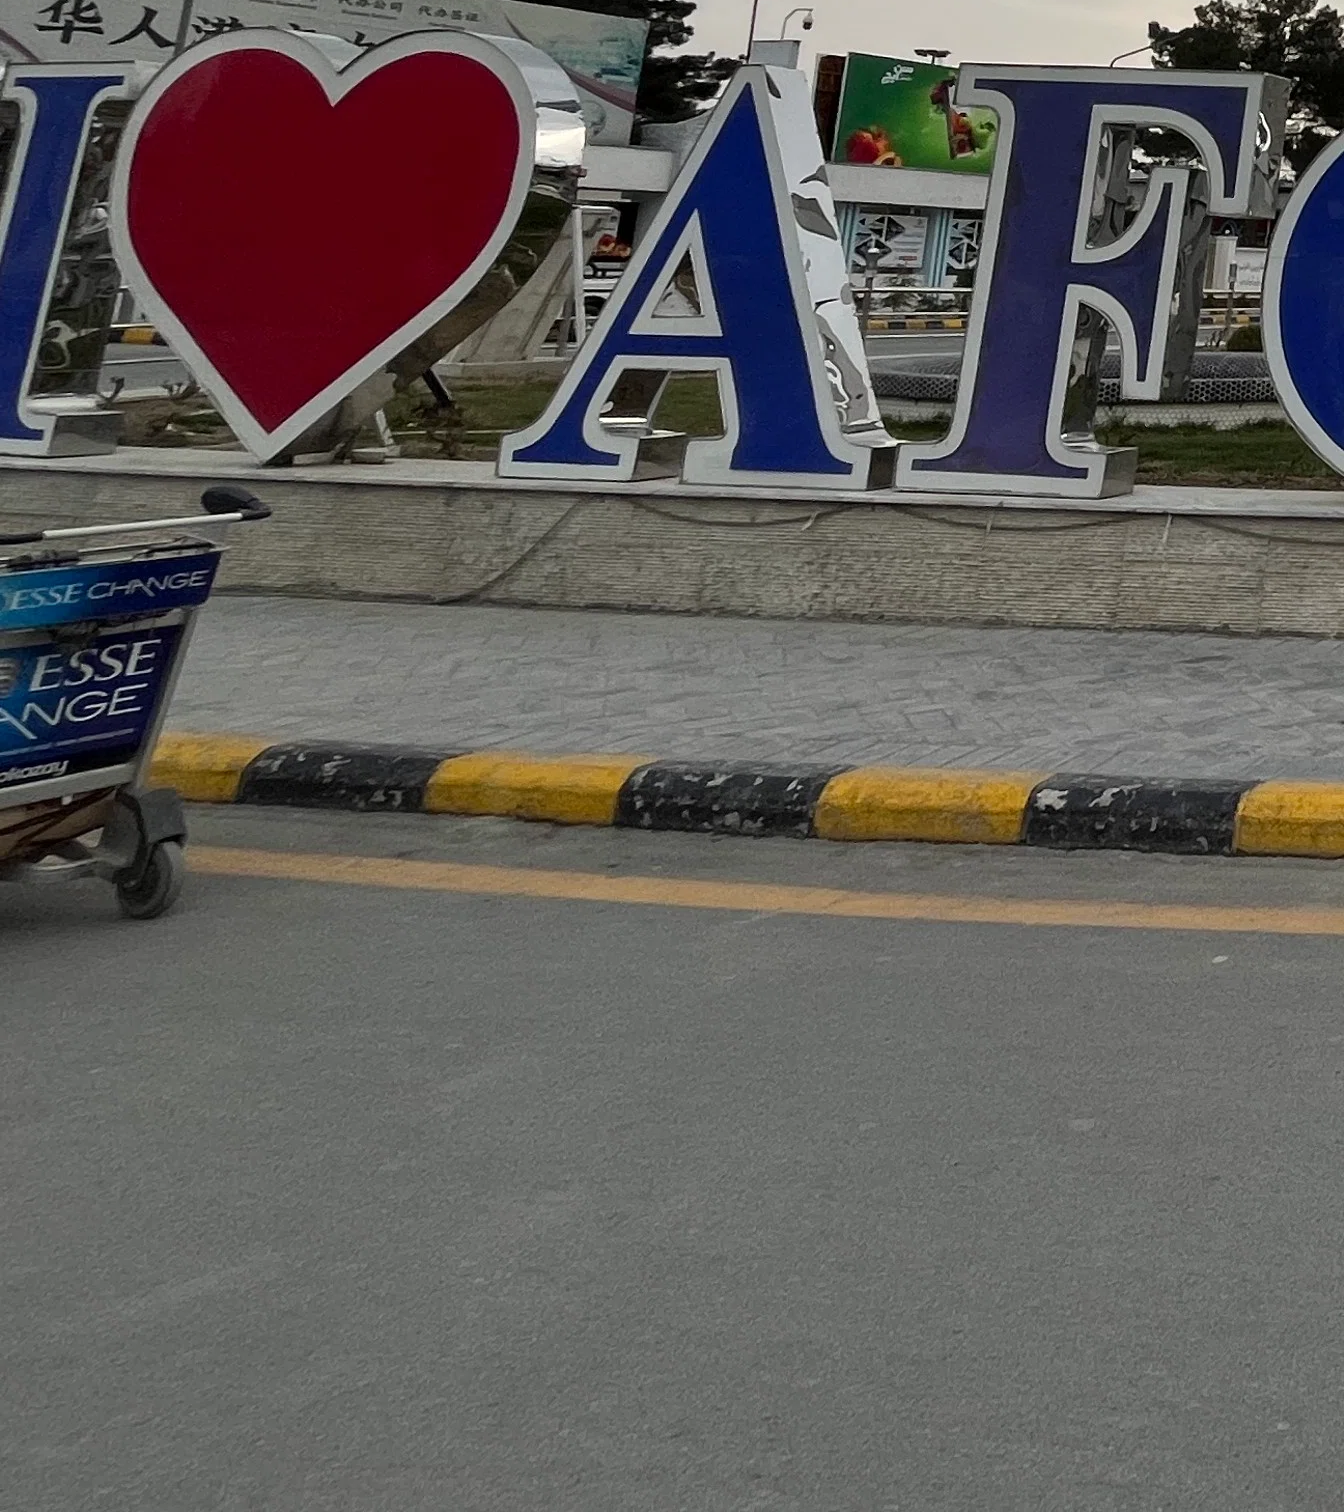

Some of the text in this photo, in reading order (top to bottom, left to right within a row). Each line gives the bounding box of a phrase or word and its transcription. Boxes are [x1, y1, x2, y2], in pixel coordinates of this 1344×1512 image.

[9, 569, 211, 610] ESSE CHANGE
[28, 639, 162, 693] ESSE
